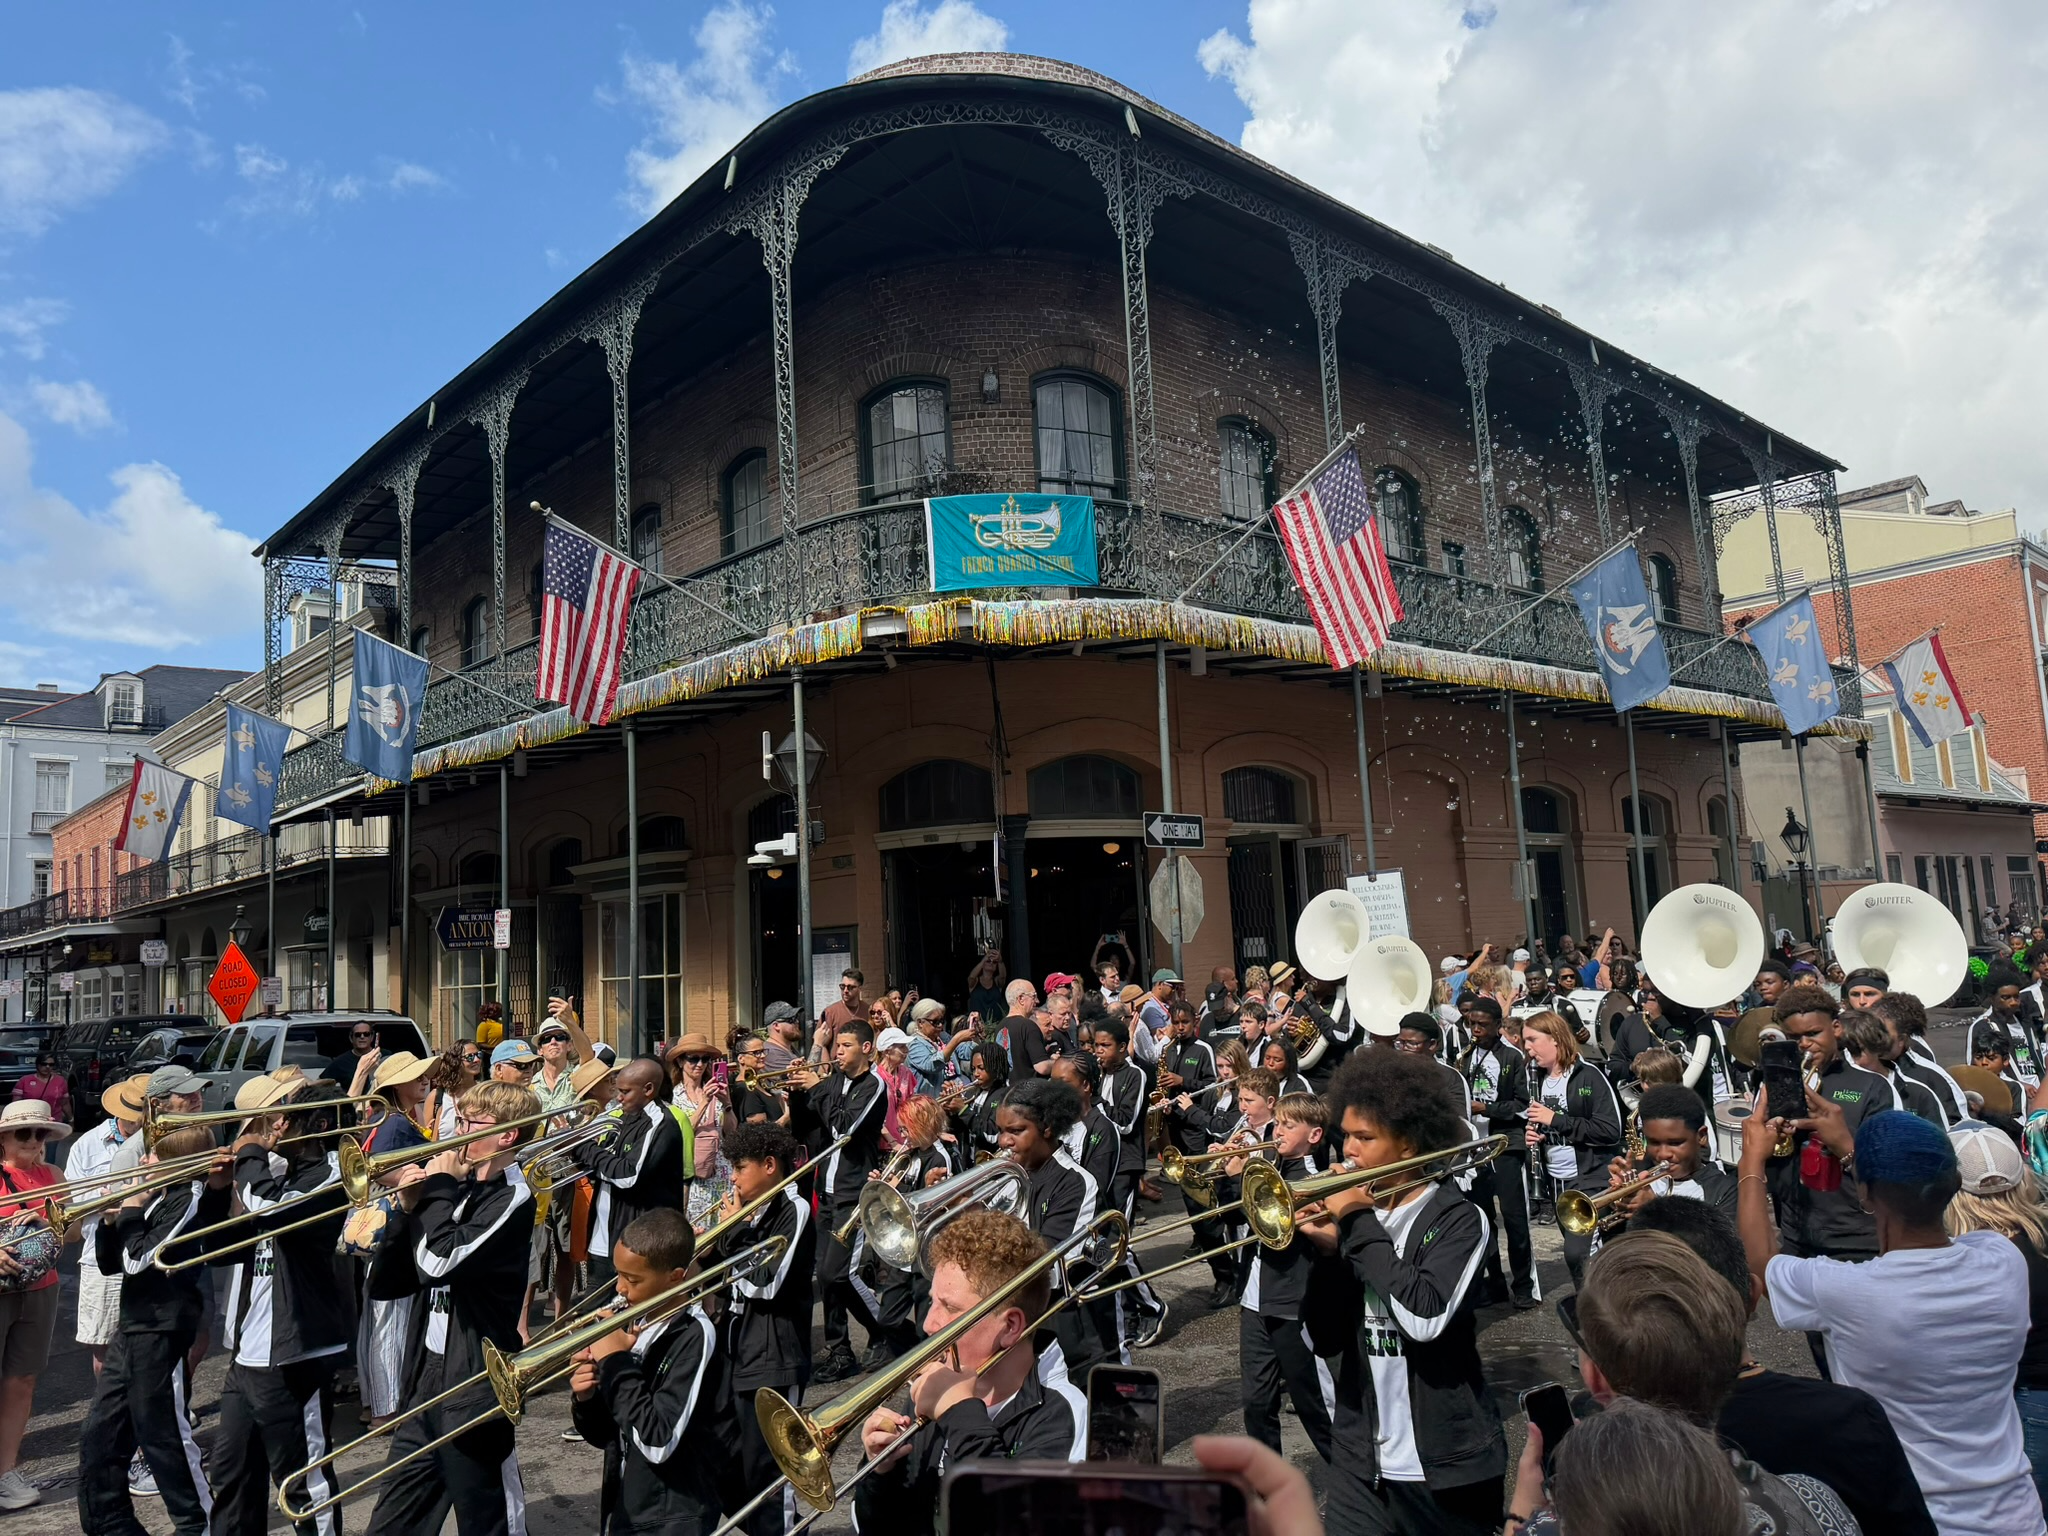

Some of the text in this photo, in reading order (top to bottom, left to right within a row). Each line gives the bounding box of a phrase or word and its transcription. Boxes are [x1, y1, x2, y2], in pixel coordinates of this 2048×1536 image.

[962, 556, 994, 575] FRENCH
[998, 554, 1036, 573] QUARTER
[1163, 824, 1197, 837] ONE WAY
[1705, 896, 1738, 912] JUPITER
[1876, 896, 1914, 906] JUPITER
[449, 921, 495, 938] ANTOIN
[223, 961, 242, 974] ROAD
[219, 976, 247, 990] CLOSED
[223, 993, 246, 1007] 500 FT
[1833, 1090, 1861, 1103] Plessy
